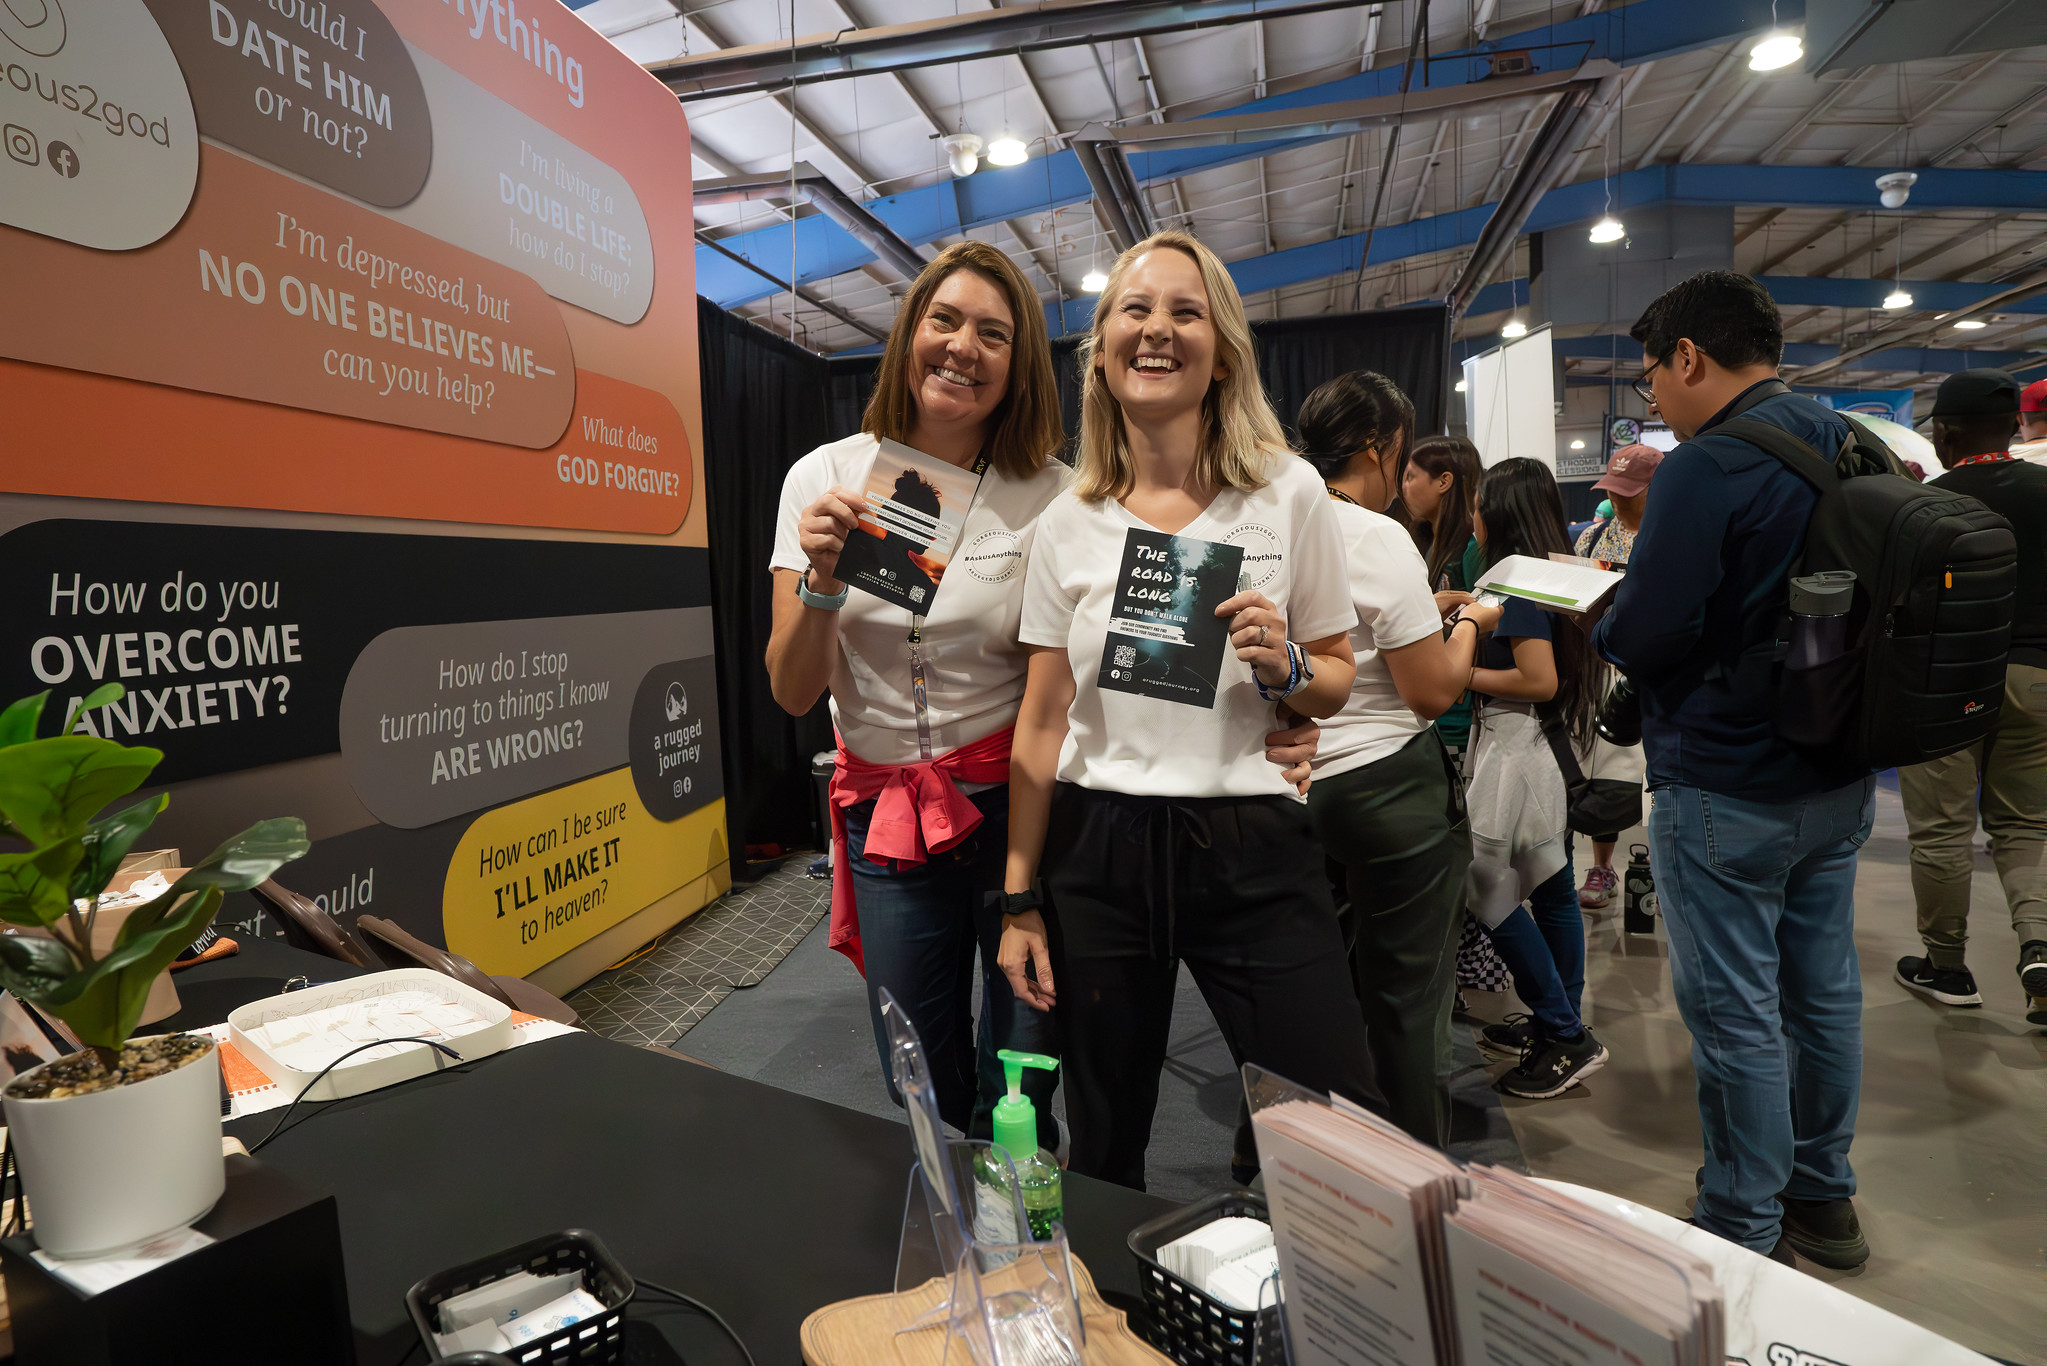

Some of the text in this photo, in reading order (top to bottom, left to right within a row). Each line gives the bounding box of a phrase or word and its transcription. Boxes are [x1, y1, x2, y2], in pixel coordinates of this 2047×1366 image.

[257, 0, 367, 61] ould I
[209, 0, 392, 131] DATE HIM
[0, 62, 170, 148] ous2god
[255, 86, 368, 159] or not?
[520, 139, 614, 215] I'm living a
[499, 172, 632, 267] DOUBLE LIFE;
[275, 211, 510, 324] I'm depressed, but
[509, 216, 630, 298] how do I stop?
[199, 248, 266, 305] NO
[279, 275, 358, 331] ONE
[368, 301, 494, 368] BELIEVES
[323, 349, 495, 415] can you help?
[582, 415, 658, 455] What does
[557, 454, 679, 497] GOD FORGIVE?
[965, 551, 1022, 561] #AskUsAnything
[1131, 566, 1198, 587] ROAD IS
[1136, 545, 1168, 562] THE
[50, 570, 279, 622] How do you
[1123, 605, 1133, 613] BUT
[1134, 607, 1143, 615] YOU
[1159, 611, 1172, 620] WALK
[1173, 614, 1188, 623] ALONE
[1127, 585, 1171, 603] LONG
[30, 624, 302, 684] OVERCOME
[439, 651, 568, 690] How do I stop
[62, 675, 291, 739] ANXIETY?
[380, 680, 610, 743] turning to things I know
[654, 718, 702, 751] a rugged
[431, 719, 584, 785] ARE WRONG?
[659, 744, 700, 777] journey
[479, 802, 626, 878] How can I be sure
[313, 867, 374, 916] ould
[494, 837, 620, 919] I'LL MAKE IT
[520, 879, 608, 945] to heaven?
